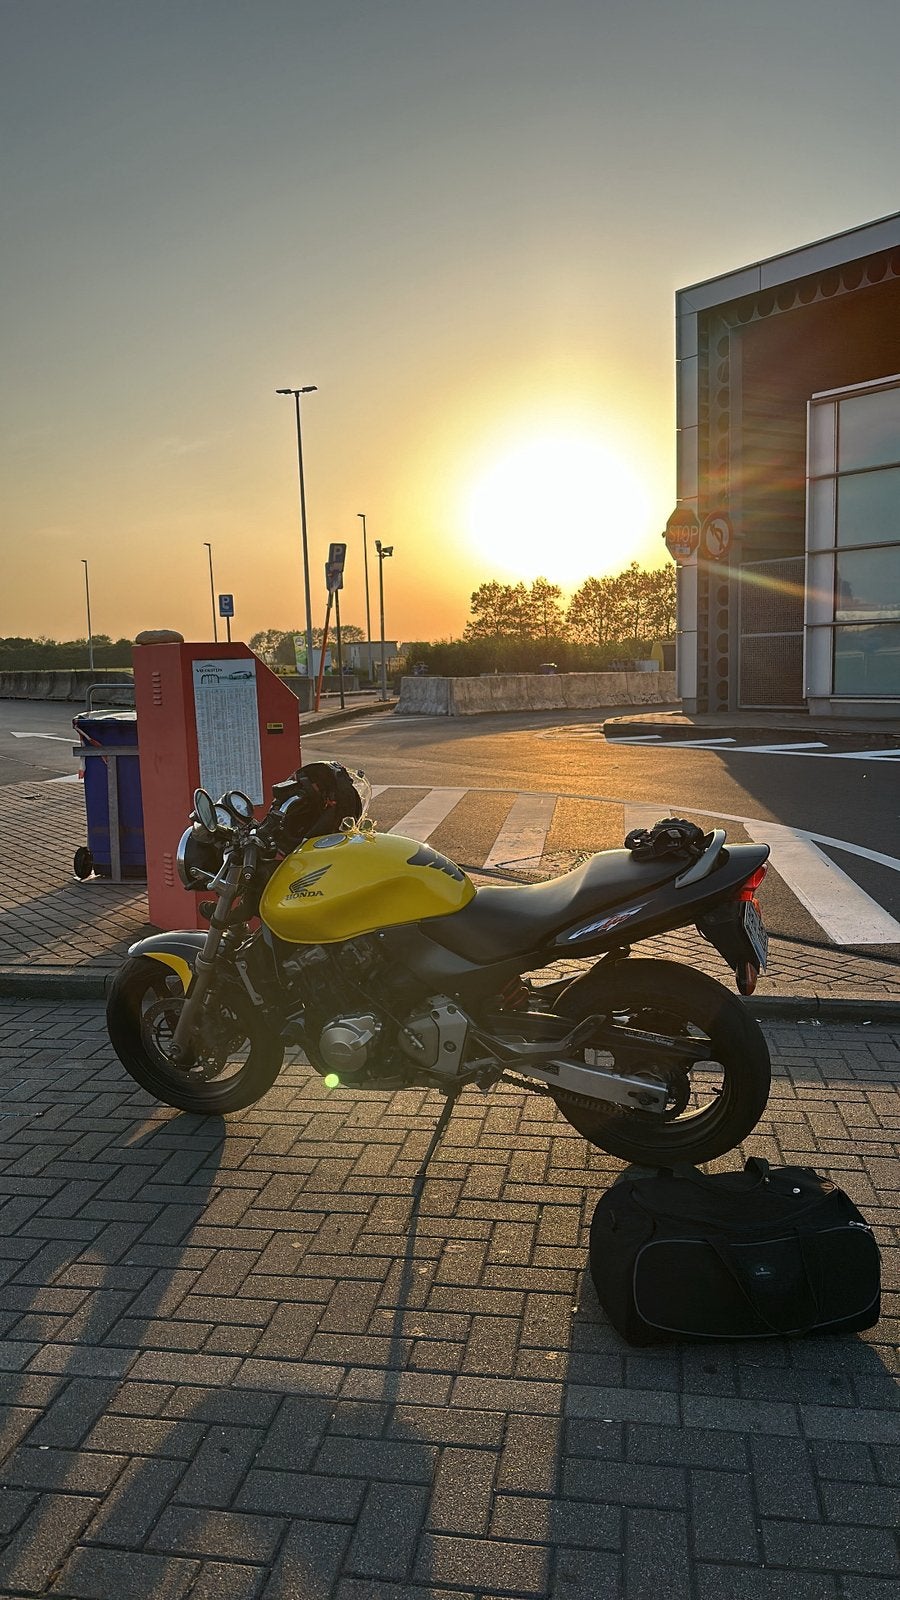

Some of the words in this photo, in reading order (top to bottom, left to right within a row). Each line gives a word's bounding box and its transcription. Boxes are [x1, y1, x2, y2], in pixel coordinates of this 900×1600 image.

[669, 525, 699, 543] STOP
[333, 545, 343, 560] P
[286, 890, 324, 901] HONDA
